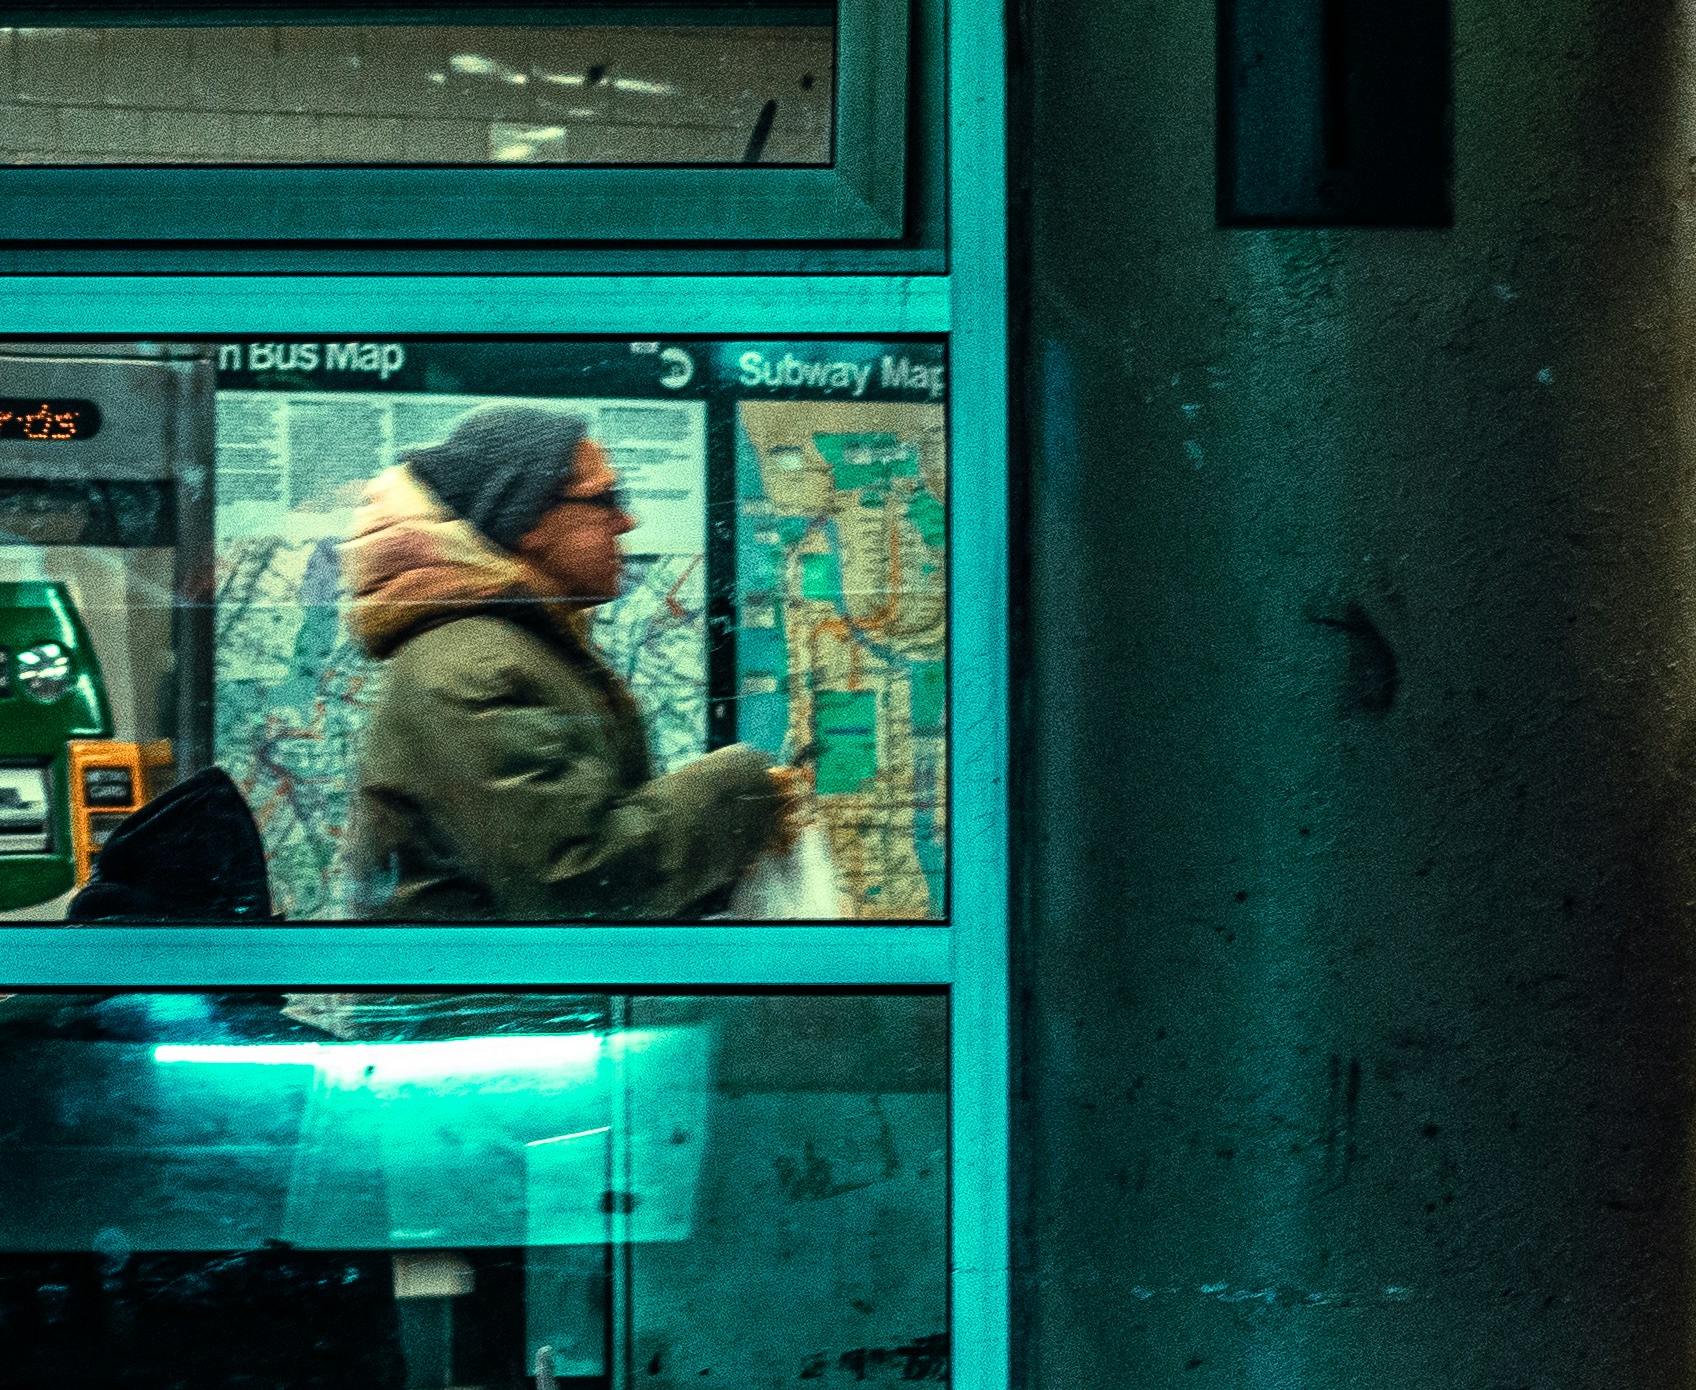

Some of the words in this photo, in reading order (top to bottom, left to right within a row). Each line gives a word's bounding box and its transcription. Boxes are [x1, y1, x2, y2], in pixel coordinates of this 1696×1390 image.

[249, 341, 320, 372] Bus
[325, 341, 406, 381] Map
[738, 350, 872, 397] Subway
